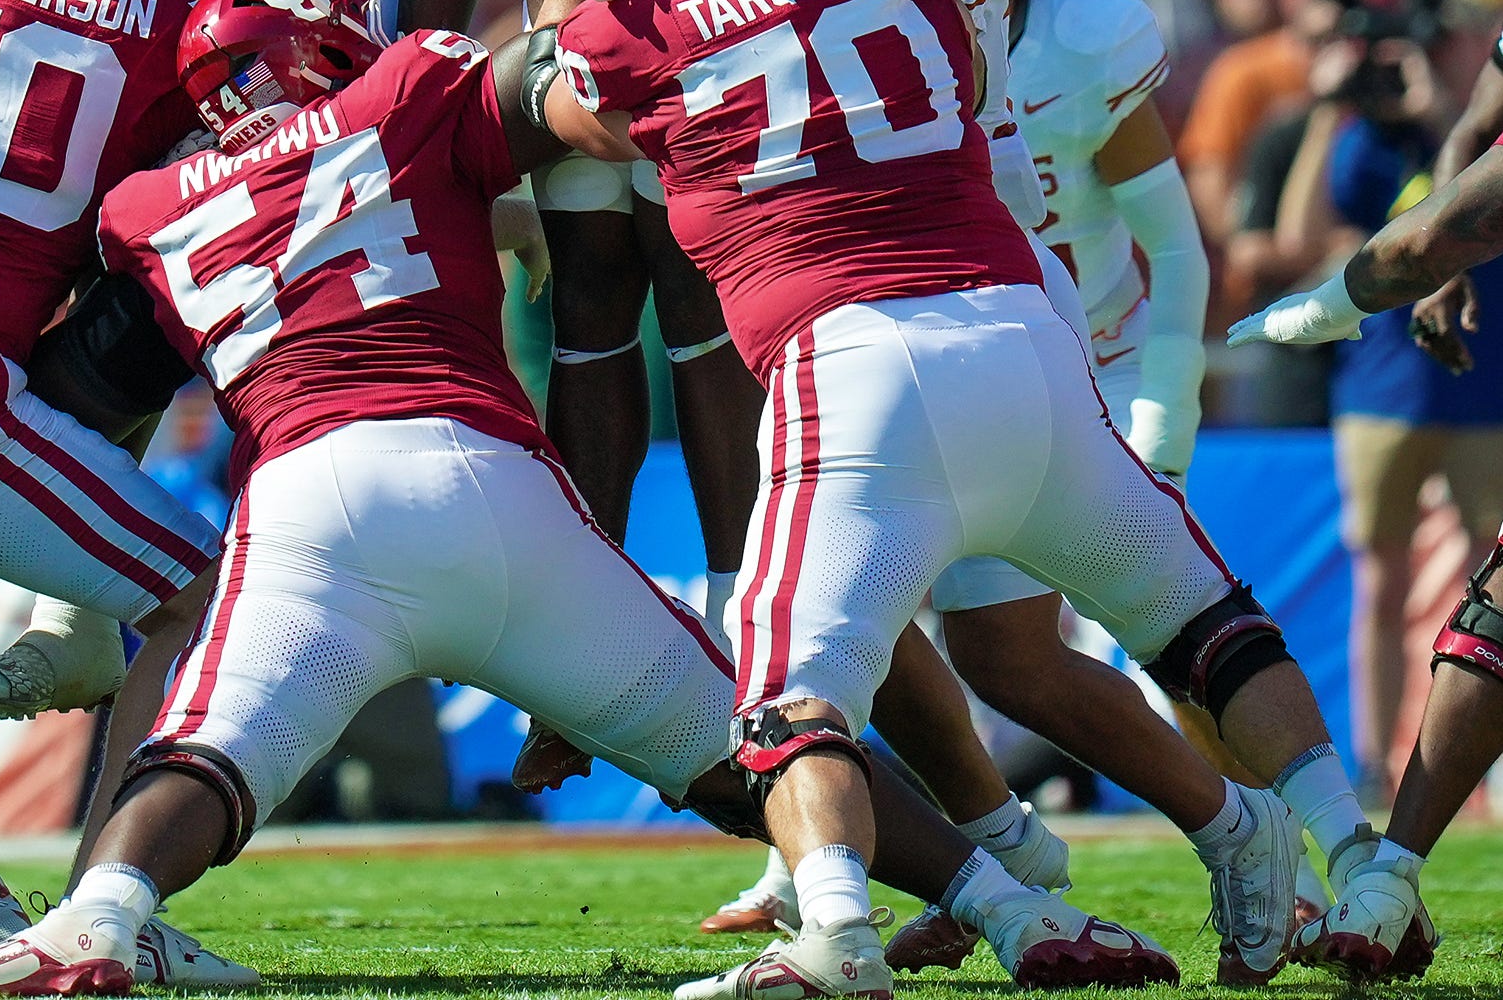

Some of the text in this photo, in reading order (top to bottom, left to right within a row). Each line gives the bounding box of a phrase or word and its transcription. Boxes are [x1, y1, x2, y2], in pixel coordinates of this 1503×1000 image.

[198, 84, 248, 132] 54
[148, 126, 441, 391] 54
[1196, 619, 1238, 666] DONJOY
[1041, 917, 1060, 932] OU
[78, 933, 92, 951] OU
[841, 960, 858, 982] OU
